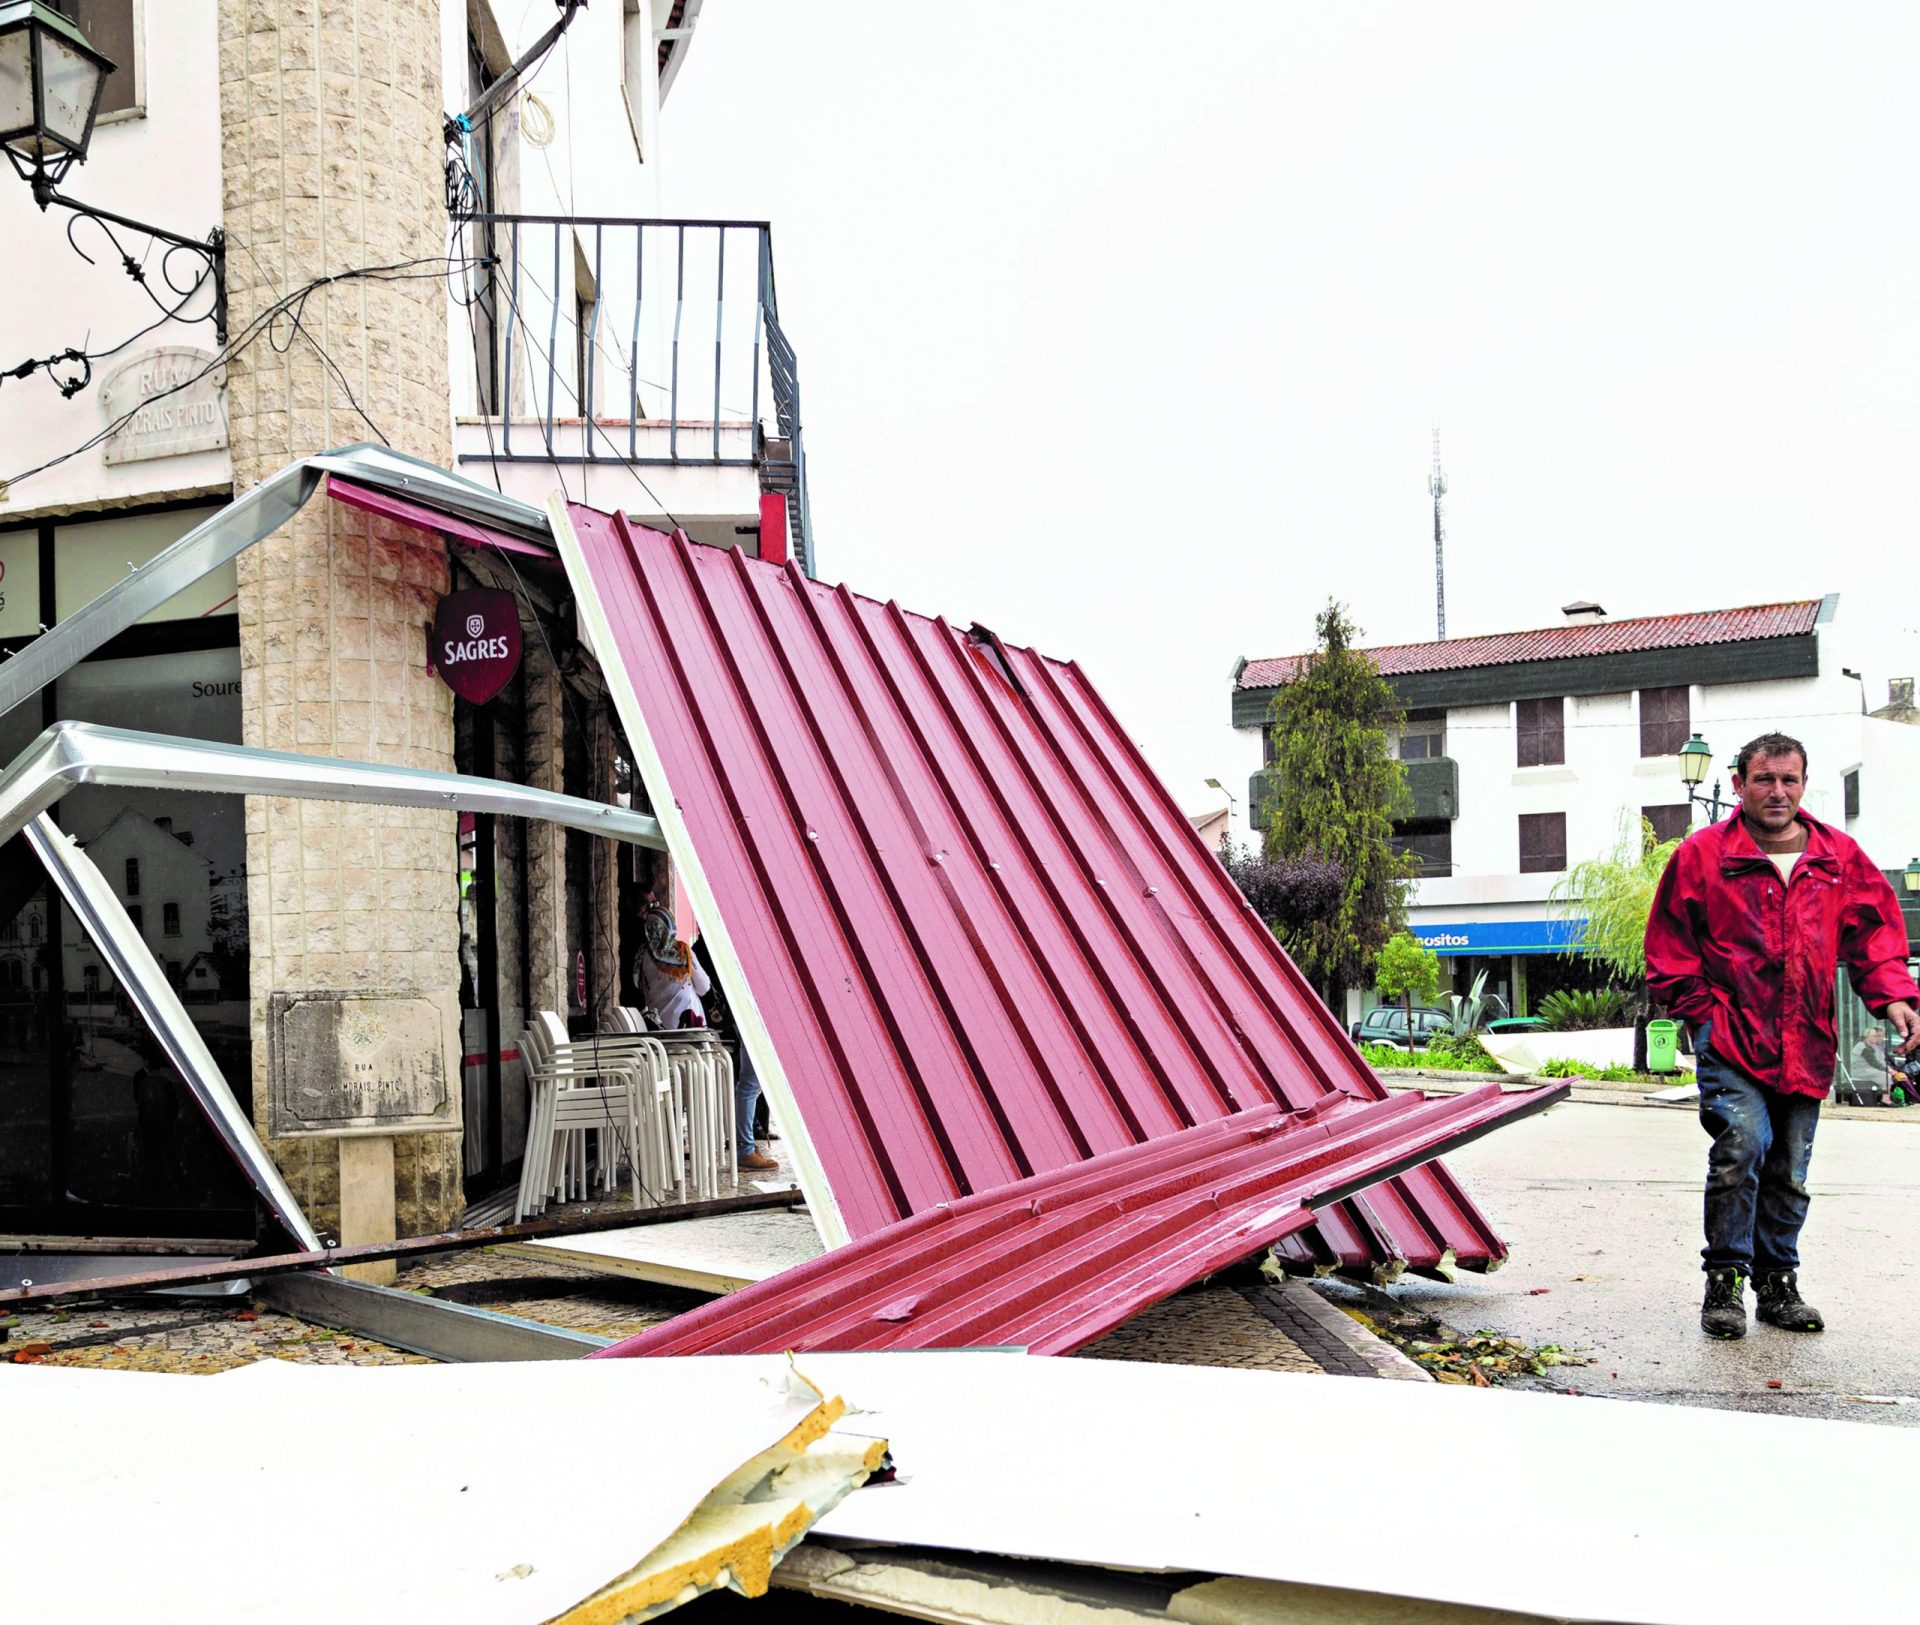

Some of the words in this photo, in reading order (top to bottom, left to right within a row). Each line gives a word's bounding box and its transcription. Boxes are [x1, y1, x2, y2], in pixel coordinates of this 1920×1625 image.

[140, 366, 183, 395] RUA
[176, 401, 215, 428] PINTO
[444, 636, 509, 665] SAGRES
[354, 1063, 373, 1072] RUA
[378, 1080, 401, 1092] PINTO
